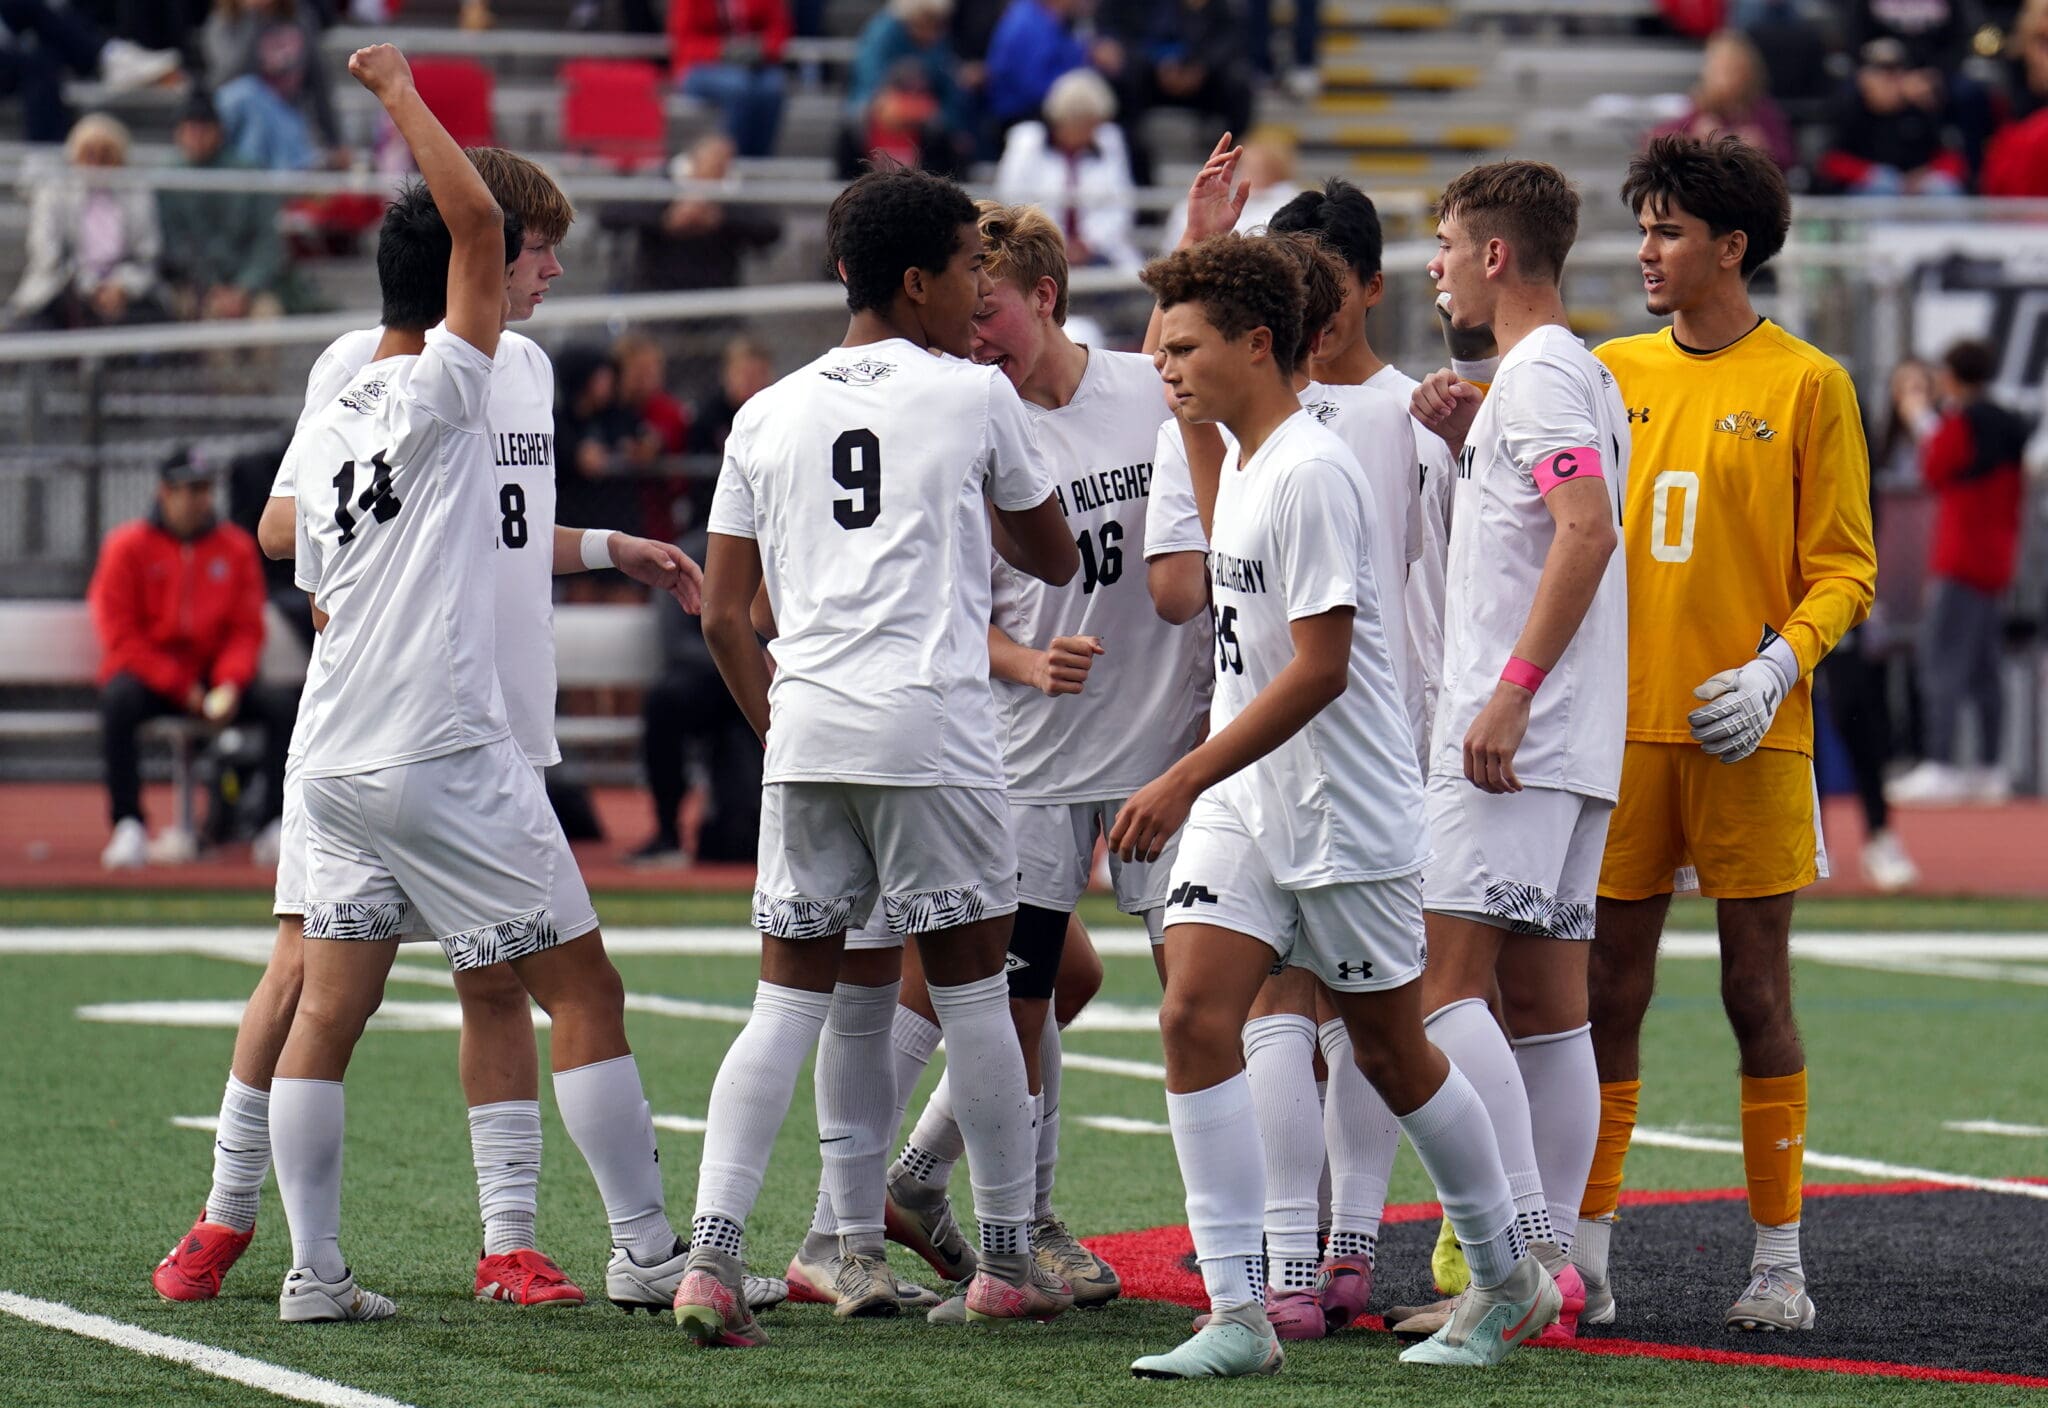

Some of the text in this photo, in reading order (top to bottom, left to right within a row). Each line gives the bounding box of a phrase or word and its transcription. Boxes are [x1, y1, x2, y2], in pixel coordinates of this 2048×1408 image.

[332, 447, 402, 547] 14
[833, 428, 881, 530] 9
[1553, 453, 1578, 478] C
[1076, 520, 1123, 594] 16
[1650, 471, 1699, 563] 0
